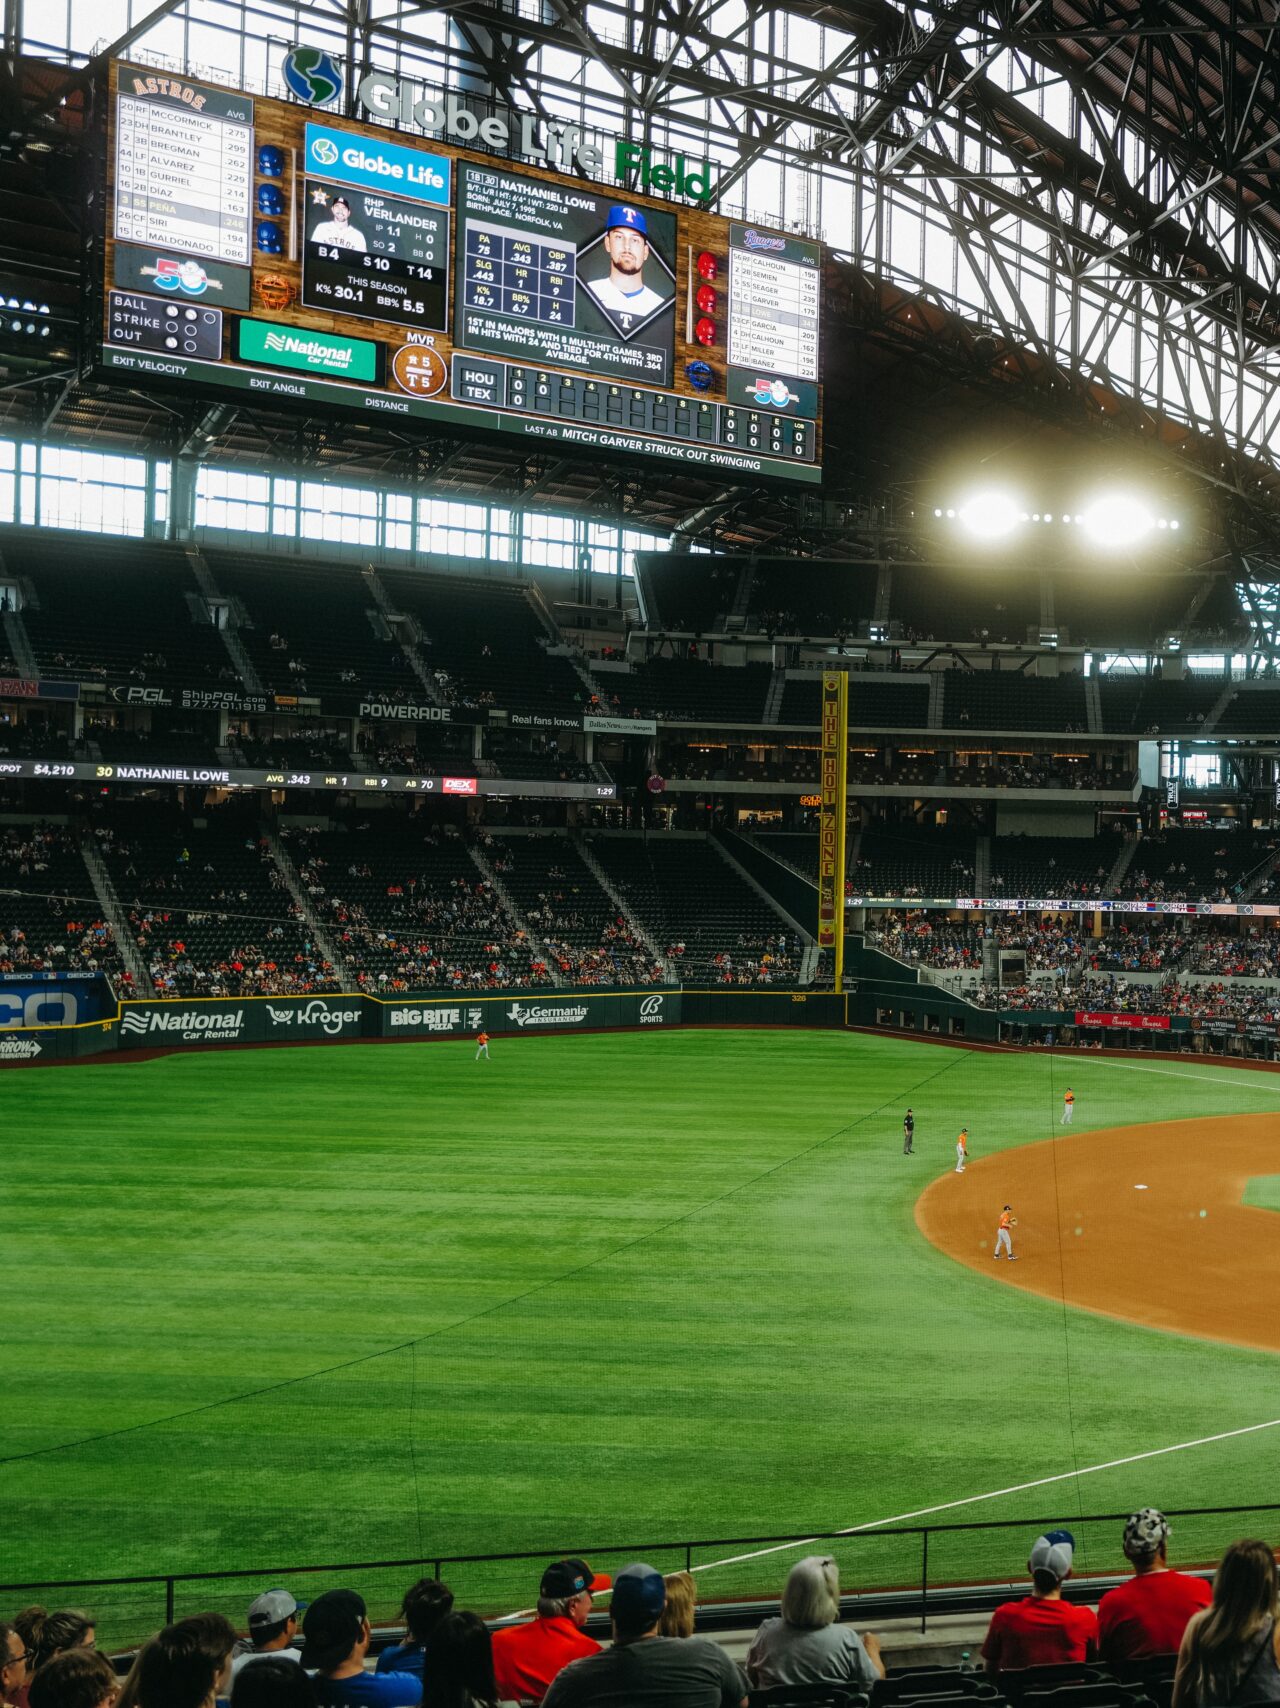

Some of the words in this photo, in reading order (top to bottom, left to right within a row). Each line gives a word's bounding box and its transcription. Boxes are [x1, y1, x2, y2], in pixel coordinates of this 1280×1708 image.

[133, 78, 206, 110] ASTROS
[151, 110, 212, 130] MCCORMICK
[226, 110, 245, 120] AVG
[151, 125, 202, 142] BRANTLEY
[360, 73, 508, 148] Globe
[521, 115, 602, 172] Life
[615, 140, 710, 199] Field
[151, 141, 200, 157] BREGMAN
[150, 156, 195, 171] ALVAREZ
[342, 149, 403, 179] Globe
[407, 163, 443, 188] Life
[150, 171, 192, 187] GURRIEL
[484, 176, 495, 185] 30
[501, 179, 563, 204] NATHANIEL
[565, 196, 595, 211] LOWE
[364, 197, 384, 207] RHP
[149, 217, 167, 227] SIRI
[364, 205, 437, 231] VERLANDER
[466, 201, 512, 218] BIRTHPLACE:
[515, 213, 551, 228] NORFOLK,
[149, 232, 213, 252] MALDONADO
[478, 245, 490, 255] 75
[511, 254, 531, 264] .343
[546, 262, 566, 272] .387
[513, 243, 530, 253] AVG
[549, 251, 565, 260] OBP
[374, 258, 390, 270] 10
[753, 258, 786, 271] CALHOUN
[418, 267, 432, 280] 14
[473, 271, 494, 281] .443
[476, 260, 492, 270] SLG
[516, 269, 527, 278] HR
[550, 276, 562, 285] RBI
[753, 271, 777, 282] SEMIEN
[347, 275, 368, 287] THIS
[370, 280, 407, 295] SEASON
[753, 283, 778, 294] SEAGER
[316, 283, 332, 294] K%
[334, 285, 363, 301] 30.1
[377, 295, 399, 308] BB%
[403, 299, 424, 313] 5.5
[477, 286, 490, 296] K%
[512, 293, 529, 304] BB%
[752, 296, 779, 307] GARVER
[114, 297, 147, 310] BALL
[473, 295, 494, 307] 18.7
[513, 303, 528, 313] 6.7
[549, 311, 561, 320] 24
[114, 313, 160, 329] STRIKE
[114, 329, 142, 341] OUT
[407, 332, 434, 346] MVR
[467, 317, 484, 326] 1ST
[486, 319, 495, 329] IN
[497, 322, 535, 337] MAJORS
[537, 330, 560, 342] WITH
[569, 336, 610, 351] MULTI-HIT
[612, 345, 644, 359] GAMES,
[646, 352, 662, 362] 3RD
[285, 337, 351, 362] National
[468, 326, 478, 335] IN
[481, 328, 501, 340] HITS
[503, 333, 526, 345] WITH
[528, 337, 539, 346] 24
[541, 340, 561, 350] AND
[563, 345, 582, 355] TIED
[584, 348, 601, 359] FOR
[603, 352, 619, 362] 4TH
[621, 355, 642, 366] WITH
[645, 360, 661, 370] .364
[307, 356, 322, 364] Car
[323, 358, 348, 368] Rental
[546, 350, 589, 364] AVERAGE.
[113, 356, 135, 367] EXIT
[137, 360, 187, 375] VELOCITY
[466, 371, 494, 385] HOU
[250, 379, 270, 389] EXIT
[273, 382, 305, 395] ANGLE
[467, 387, 490, 399] TEX
[365, 398, 408, 412] DISTANCE
[525, 425, 544, 434] LAST
[562, 429, 596, 443] MITCH
[600, 436, 642, 450] GARVER
[645, 443, 684, 457] STRUCK
[687, 450, 708, 460] OUT
[710, 454, 761, 470] SWINGING
[127, 687, 172, 702] PGL
[182, 690, 267, 704] ShipPGL.com
[182, 699, 266, 712] 877.701.1919
[360, 703, 450, 721] POWERADE
[512, 715, 530, 725] Real
[533, 716, 551, 725] fans
[553, 718, 579, 728] know.
[826, 702, 836, 746] THE
[34, 765, 74, 777] $4,210
[96, 767, 112, 777] 30
[117, 767, 189, 780] NATHANIEL
[193, 771, 229, 782] LOWE
[267, 775, 284, 784] AVG
[288, 775, 310, 785] .343
[421, 780, 433, 789] 70
[445, 780, 472, 788] DEX
[825, 759, 835, 805] HOT
[597, 787, 613, 795] 1:29
[823, 815, 835, 876] ZONE
[531, 1005, 587, 1017] Germania
[640, 1015, 663, 1023] SPORTS
[150, 1010, 244, 1031] National
[429, 1021, 453, 1031] PIZZA
[183, 1030, 202, 1040] Car
[204, 1029, 239, 1039] Rental
